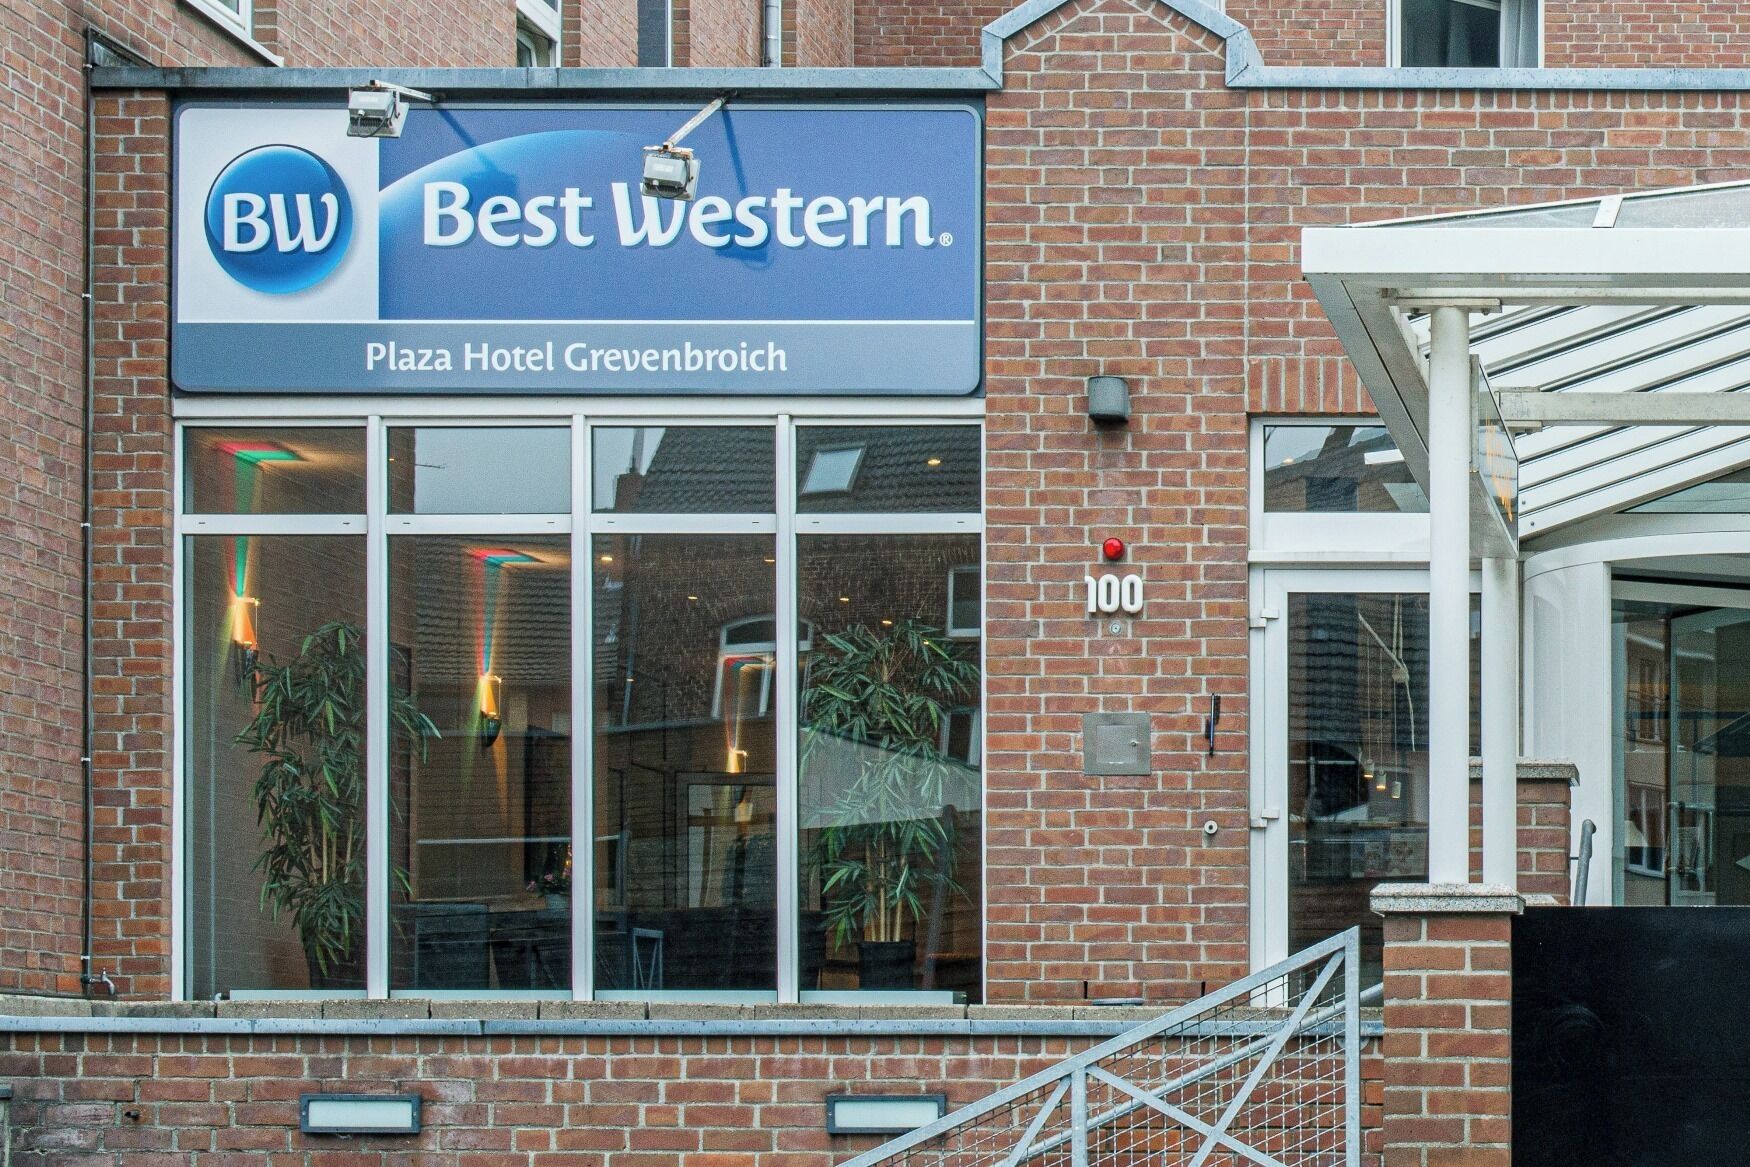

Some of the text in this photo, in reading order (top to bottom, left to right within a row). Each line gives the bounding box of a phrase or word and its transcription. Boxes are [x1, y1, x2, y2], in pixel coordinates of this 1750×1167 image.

[223, 191, 338, 253] BW
[422, 180, 595, 248] Best
[365, 340, 789, 373] Plaza Hotel Grevenbroich
[1084, 572, 1145, 615] 100
